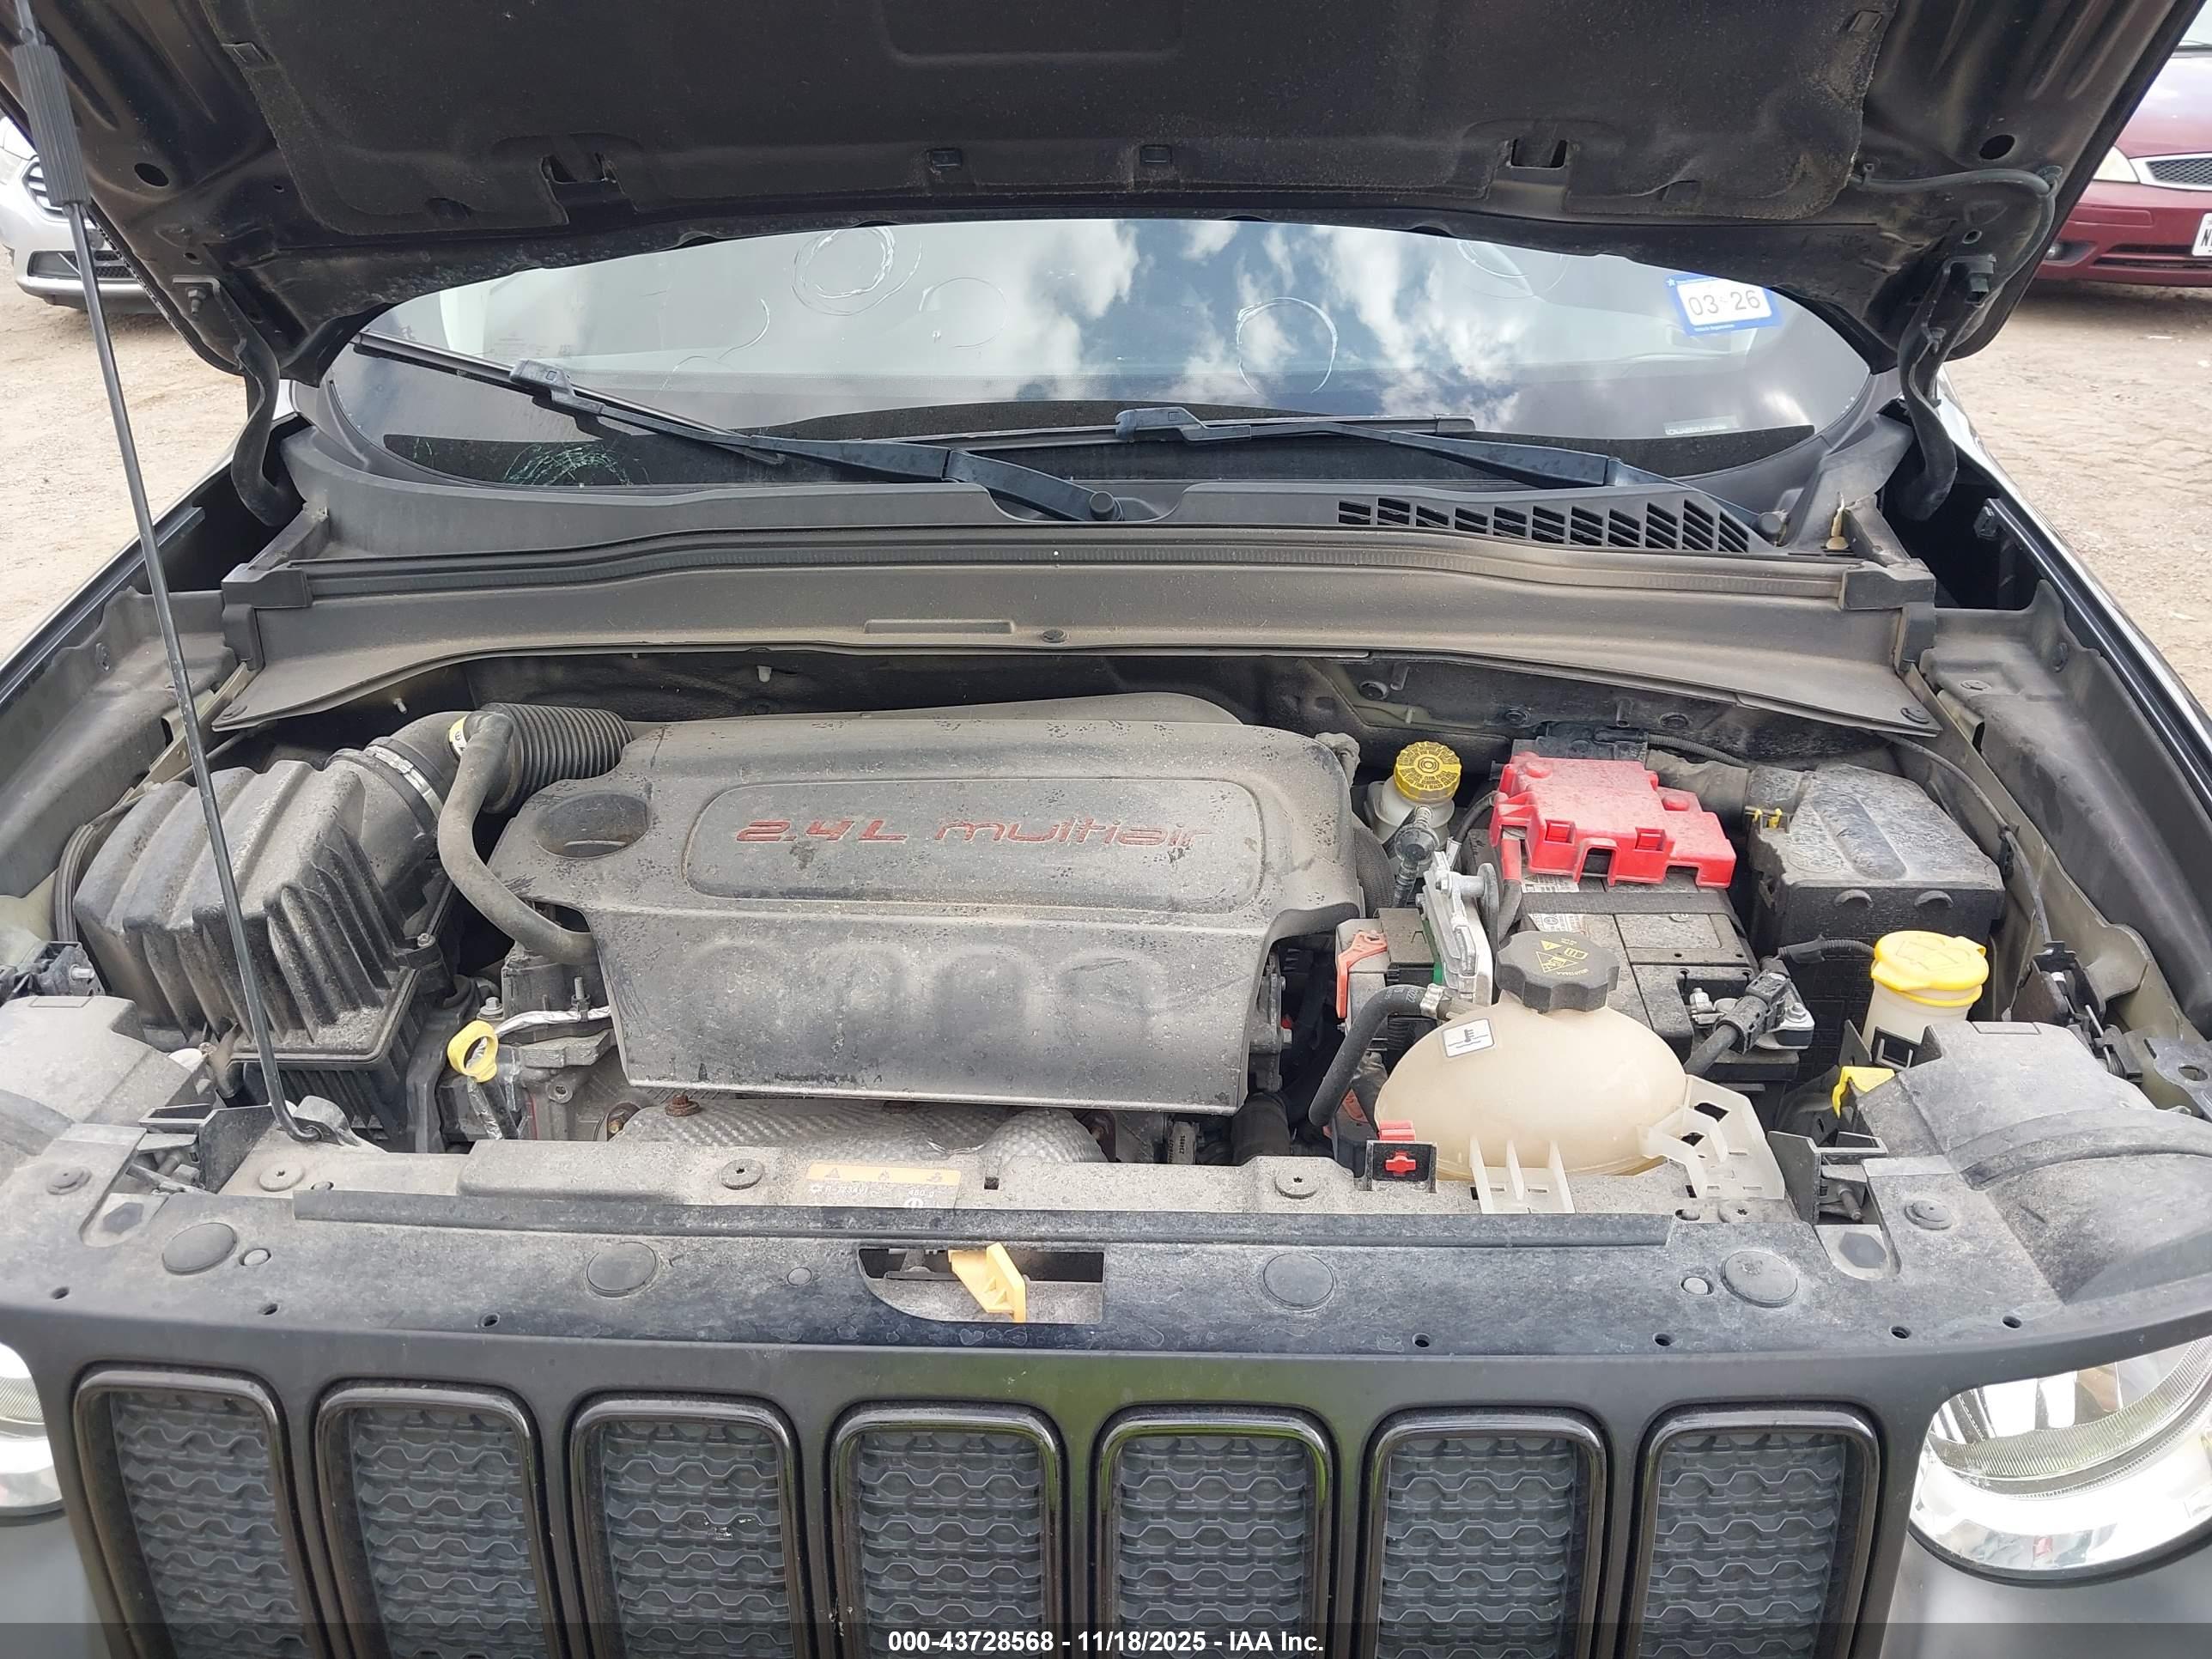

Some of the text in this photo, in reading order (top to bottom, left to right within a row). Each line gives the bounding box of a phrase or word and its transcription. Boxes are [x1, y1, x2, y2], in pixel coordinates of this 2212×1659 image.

[1688, 289, 1761, 316] 03 26
[736, 817, 1212, 848] 2.4L multiair
